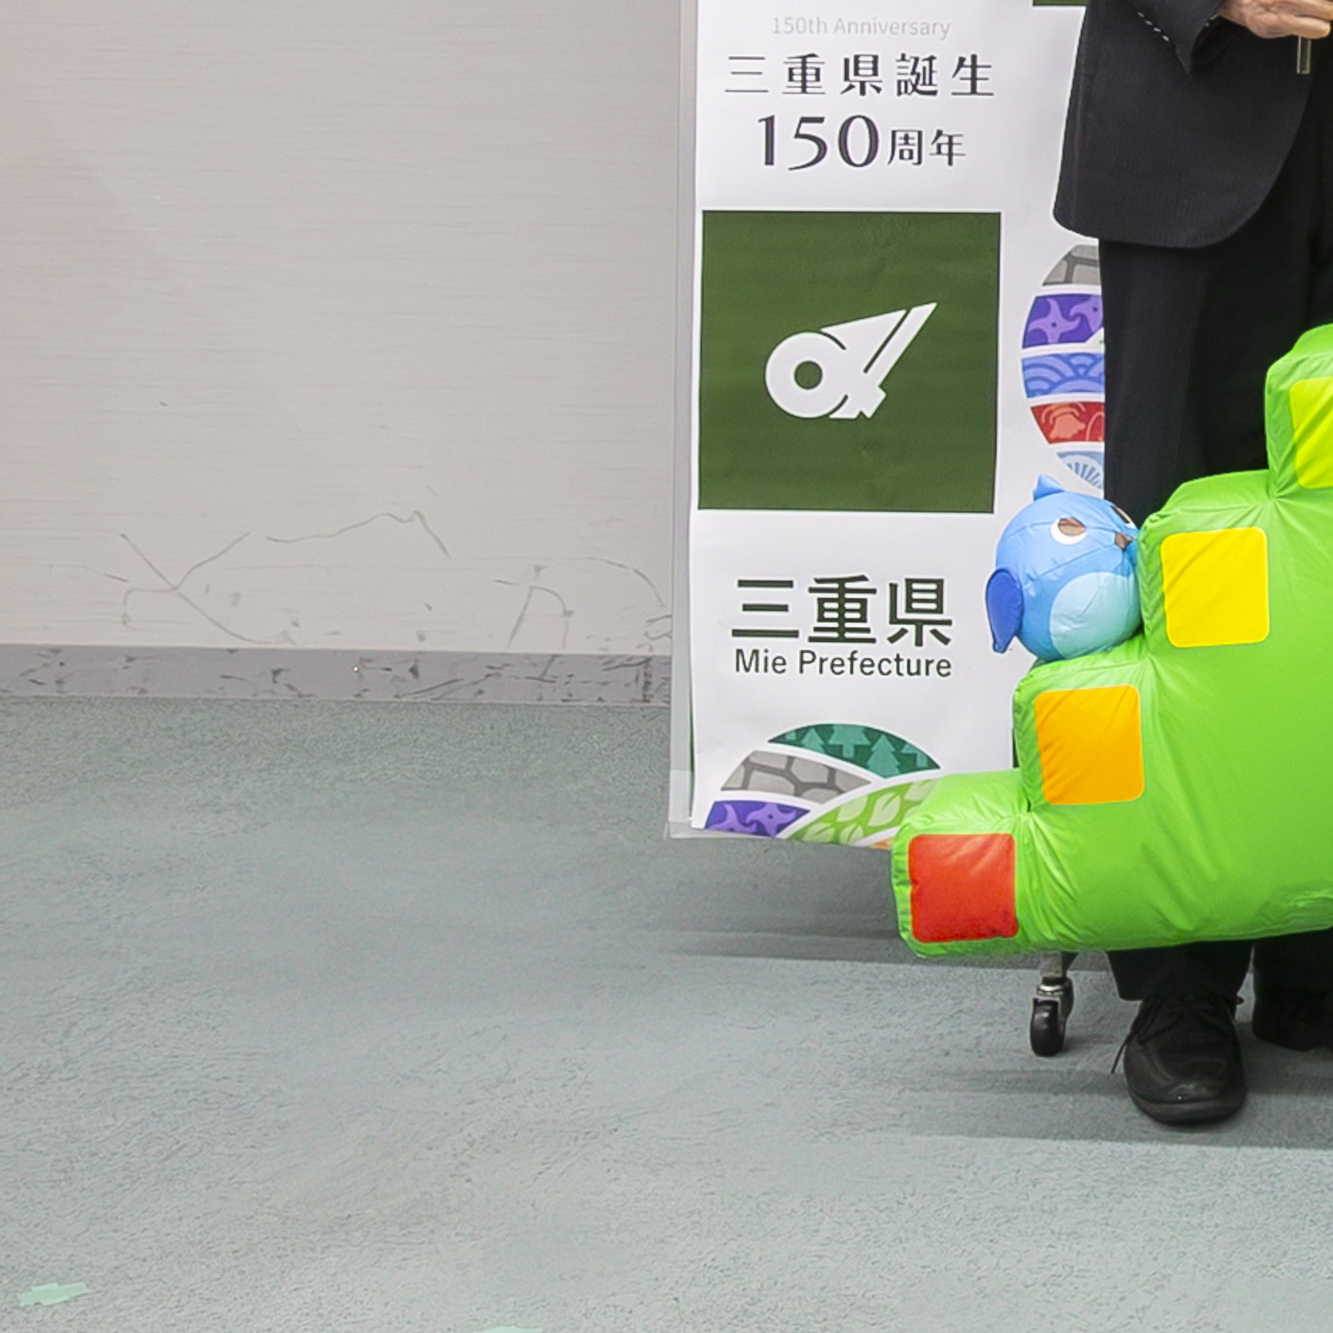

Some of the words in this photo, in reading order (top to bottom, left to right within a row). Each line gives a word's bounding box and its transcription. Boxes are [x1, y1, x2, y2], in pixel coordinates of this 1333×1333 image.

[773, 16, 827, 34] 150th
[834, 17, 950, 41] Anniversary
[726, 53, 994, 96] 三重県誕生
[759, 115, 964, 170] 150周年
[732, 575, 952, 647] 三重県
[736, 649, 786, 674] Mie
[799, 650, 951, 677] Prefecture
